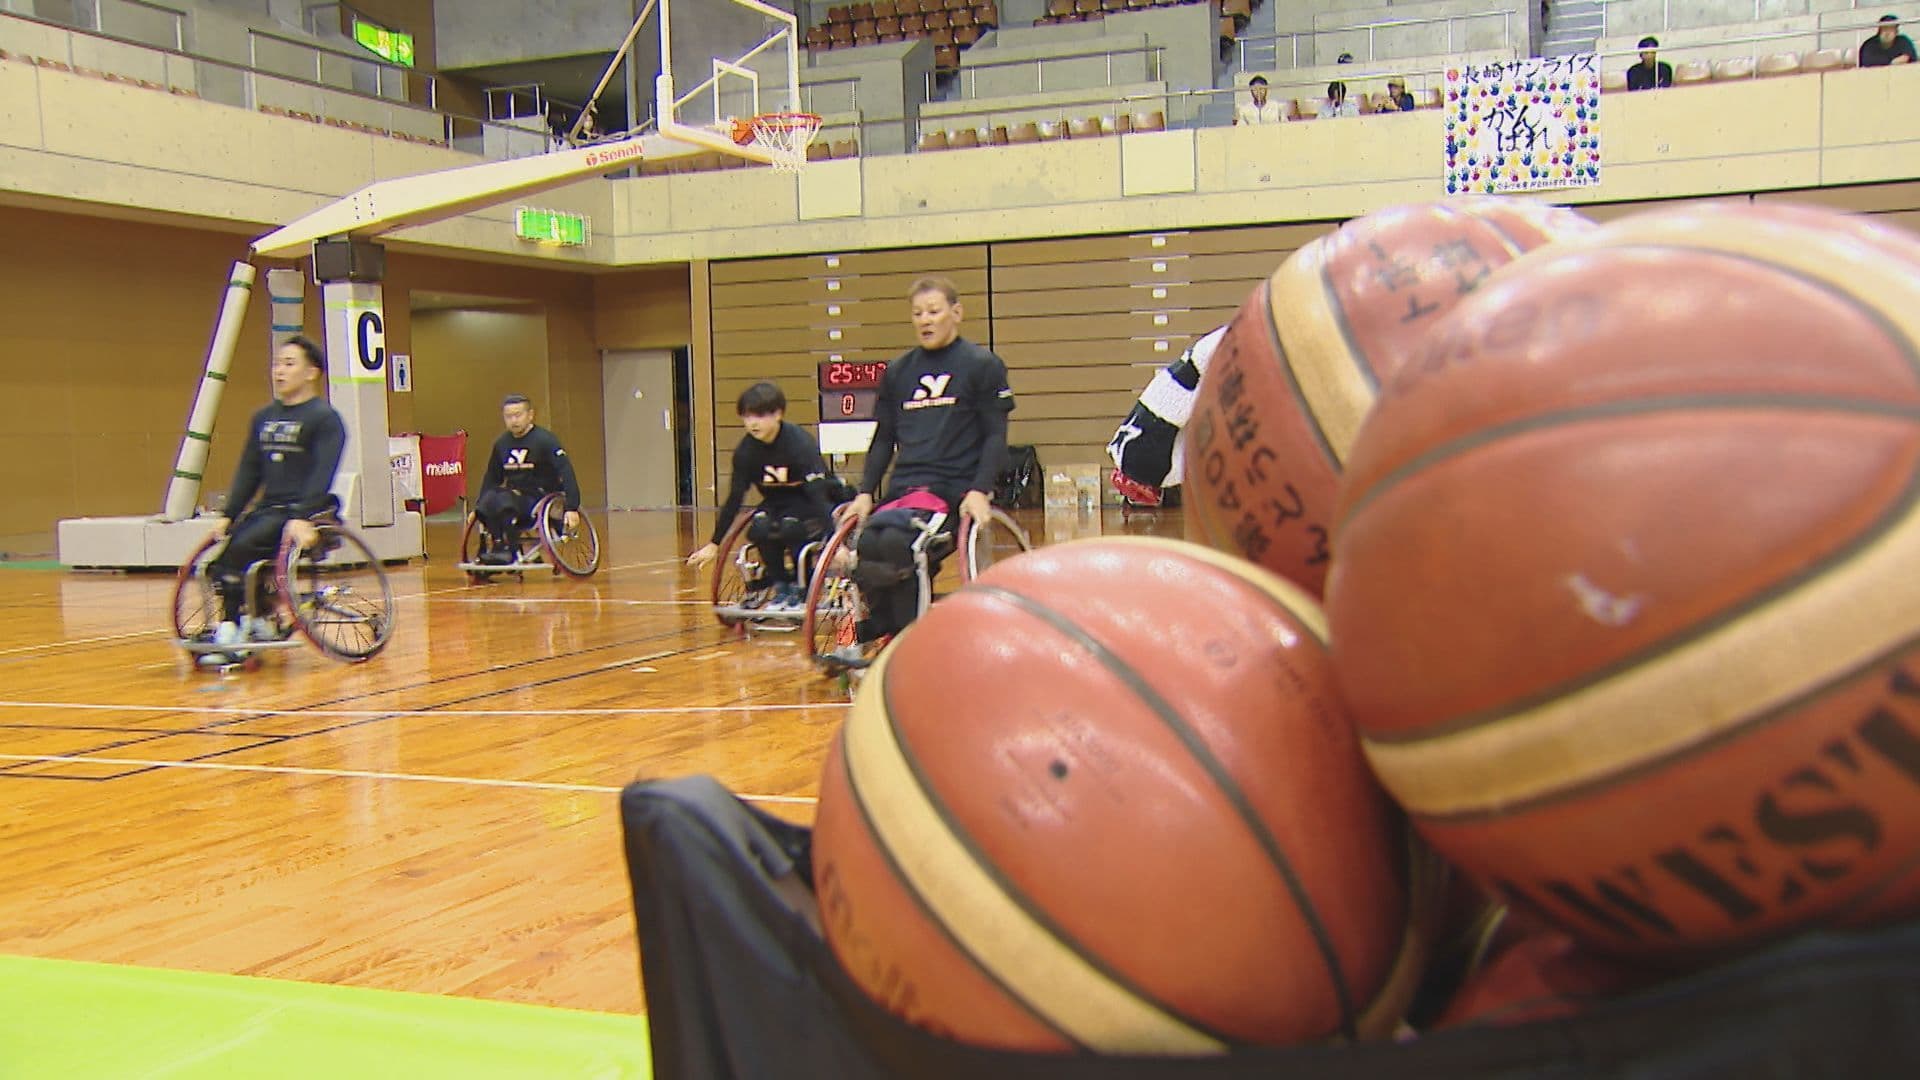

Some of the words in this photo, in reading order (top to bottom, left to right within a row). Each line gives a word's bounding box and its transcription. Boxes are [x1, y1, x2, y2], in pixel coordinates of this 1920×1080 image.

[599, 143, 643, 162] Senoh
[357, 310, 384, 371] C
[842, 394, 855, 415] 0
[426, 461, 462, 476] molten
